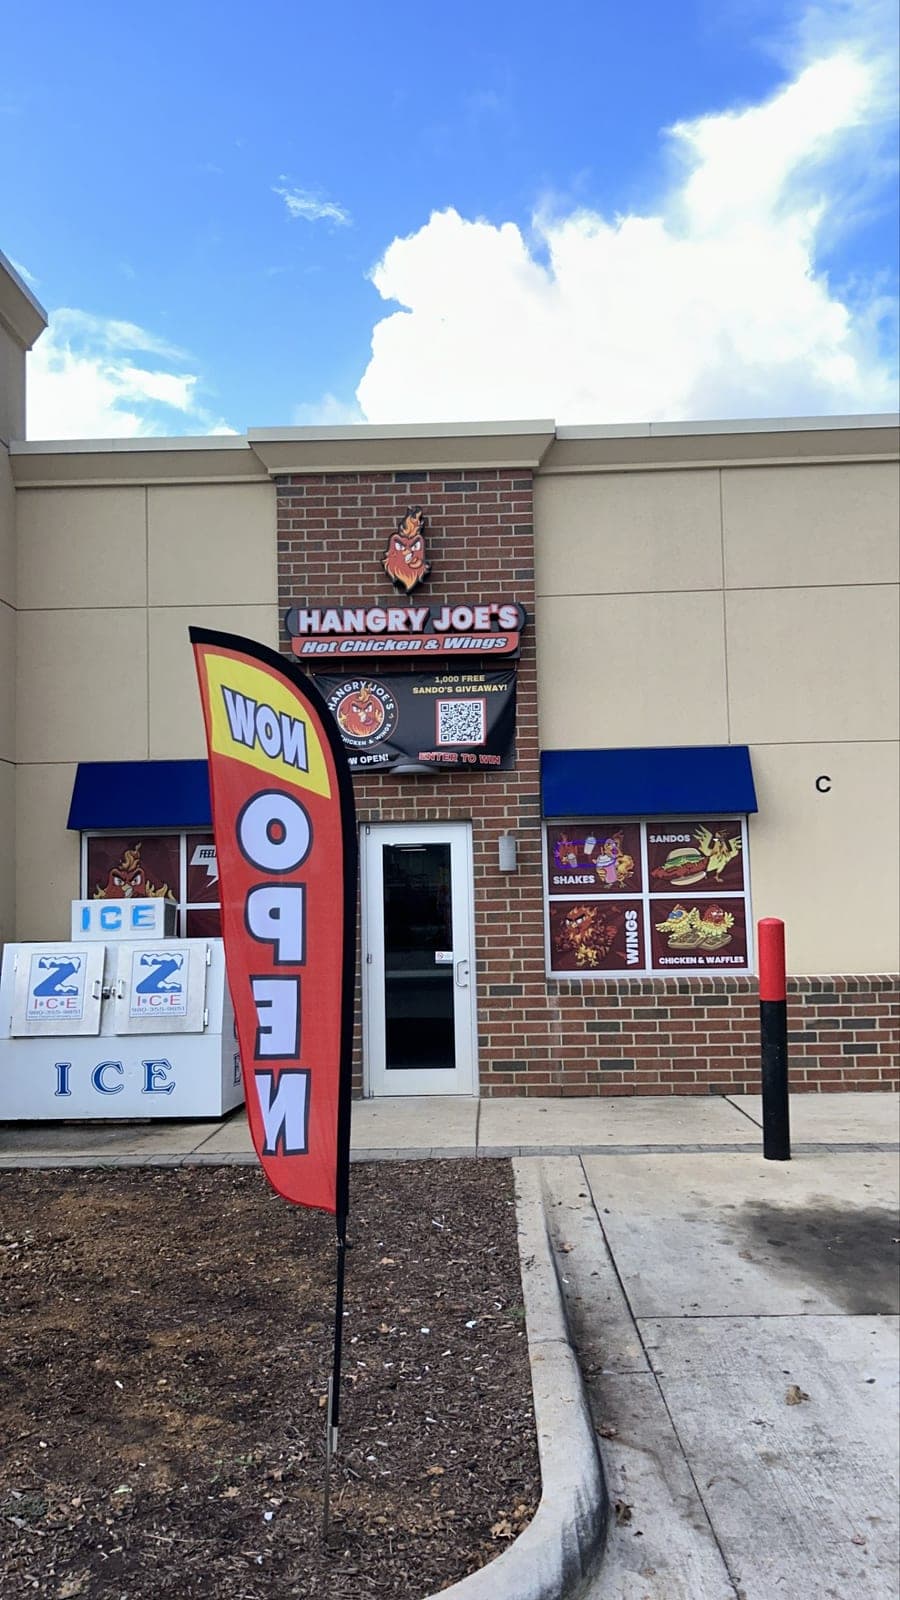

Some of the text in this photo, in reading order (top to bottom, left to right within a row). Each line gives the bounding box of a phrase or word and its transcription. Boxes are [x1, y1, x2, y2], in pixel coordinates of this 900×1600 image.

[299, 603, 519, 632] HANGRY JOE'S
[302, 636, 508, 653] Hot Chicken & Wings
[435, 676, 459, 684] 1,000
[412, 684, 508, 694] SANDO'S GIVEAWAY!
[328, 681, 395, 711] HANGRY JOE'S
[341, 734, 367, 746] HICKEN
[360, 753, 389, 764] OPEN!
[418, 752, 501, 765] ENTER TO WIN
[815, 775, 832, 793] C
[649, 834, 691, 843] SANDOS
[553, 875, 596, 885] SHAKES
[81, 905, 156, 931] ICE
[625, 910, 639, 965] WINGS
[658, 956, 697, 965] CHICKEN
[705, 956, 745, 964] WAFFLES
[54, 1058, 176, 1097] ICE
